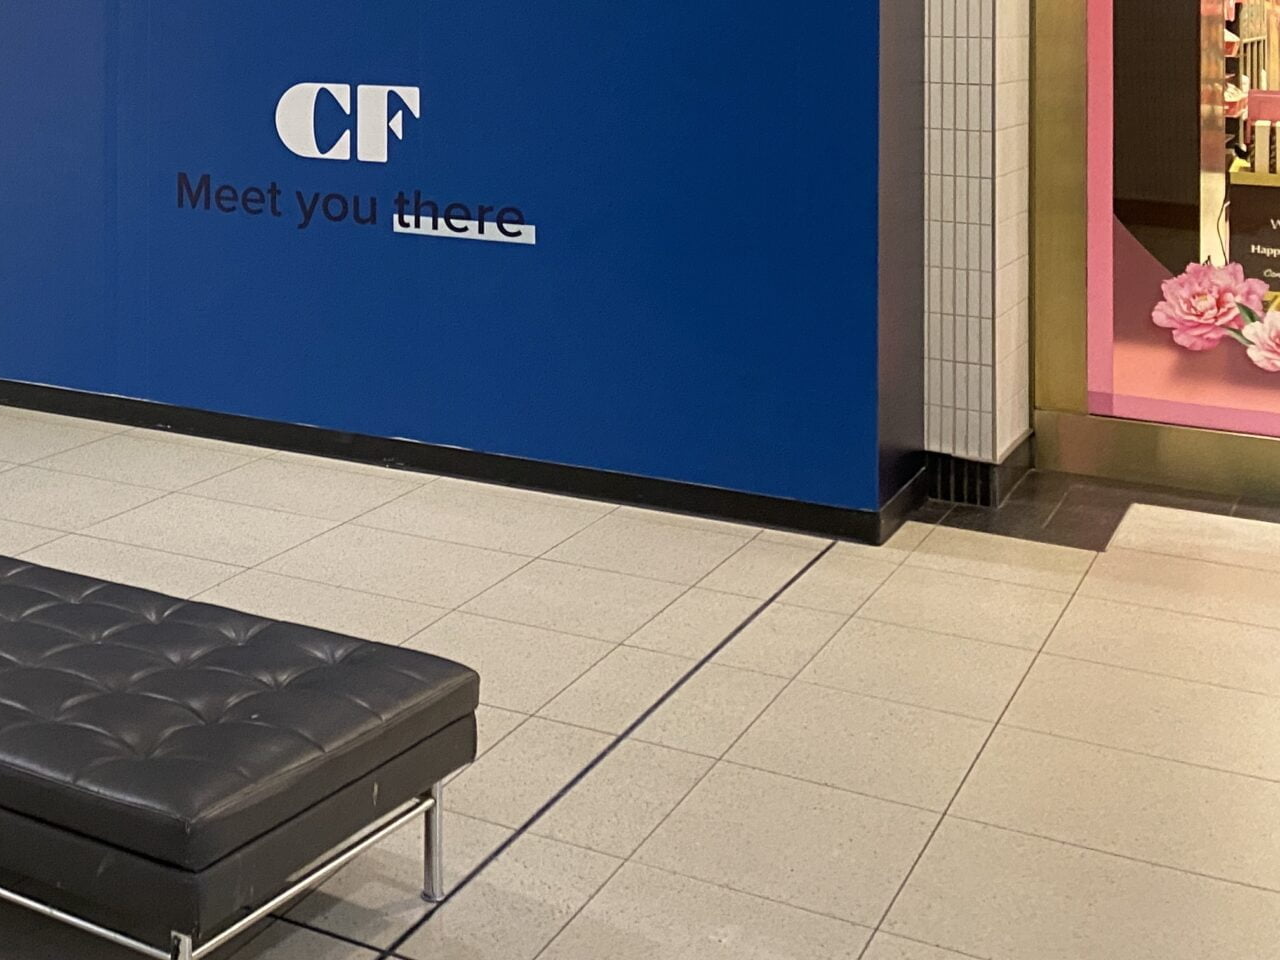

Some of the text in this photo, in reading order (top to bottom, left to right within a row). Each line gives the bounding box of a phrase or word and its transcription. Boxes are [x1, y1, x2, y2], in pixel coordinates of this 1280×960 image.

[275, 81, 420, 163] CF
[176, 171, 527, 239] Meet you there
